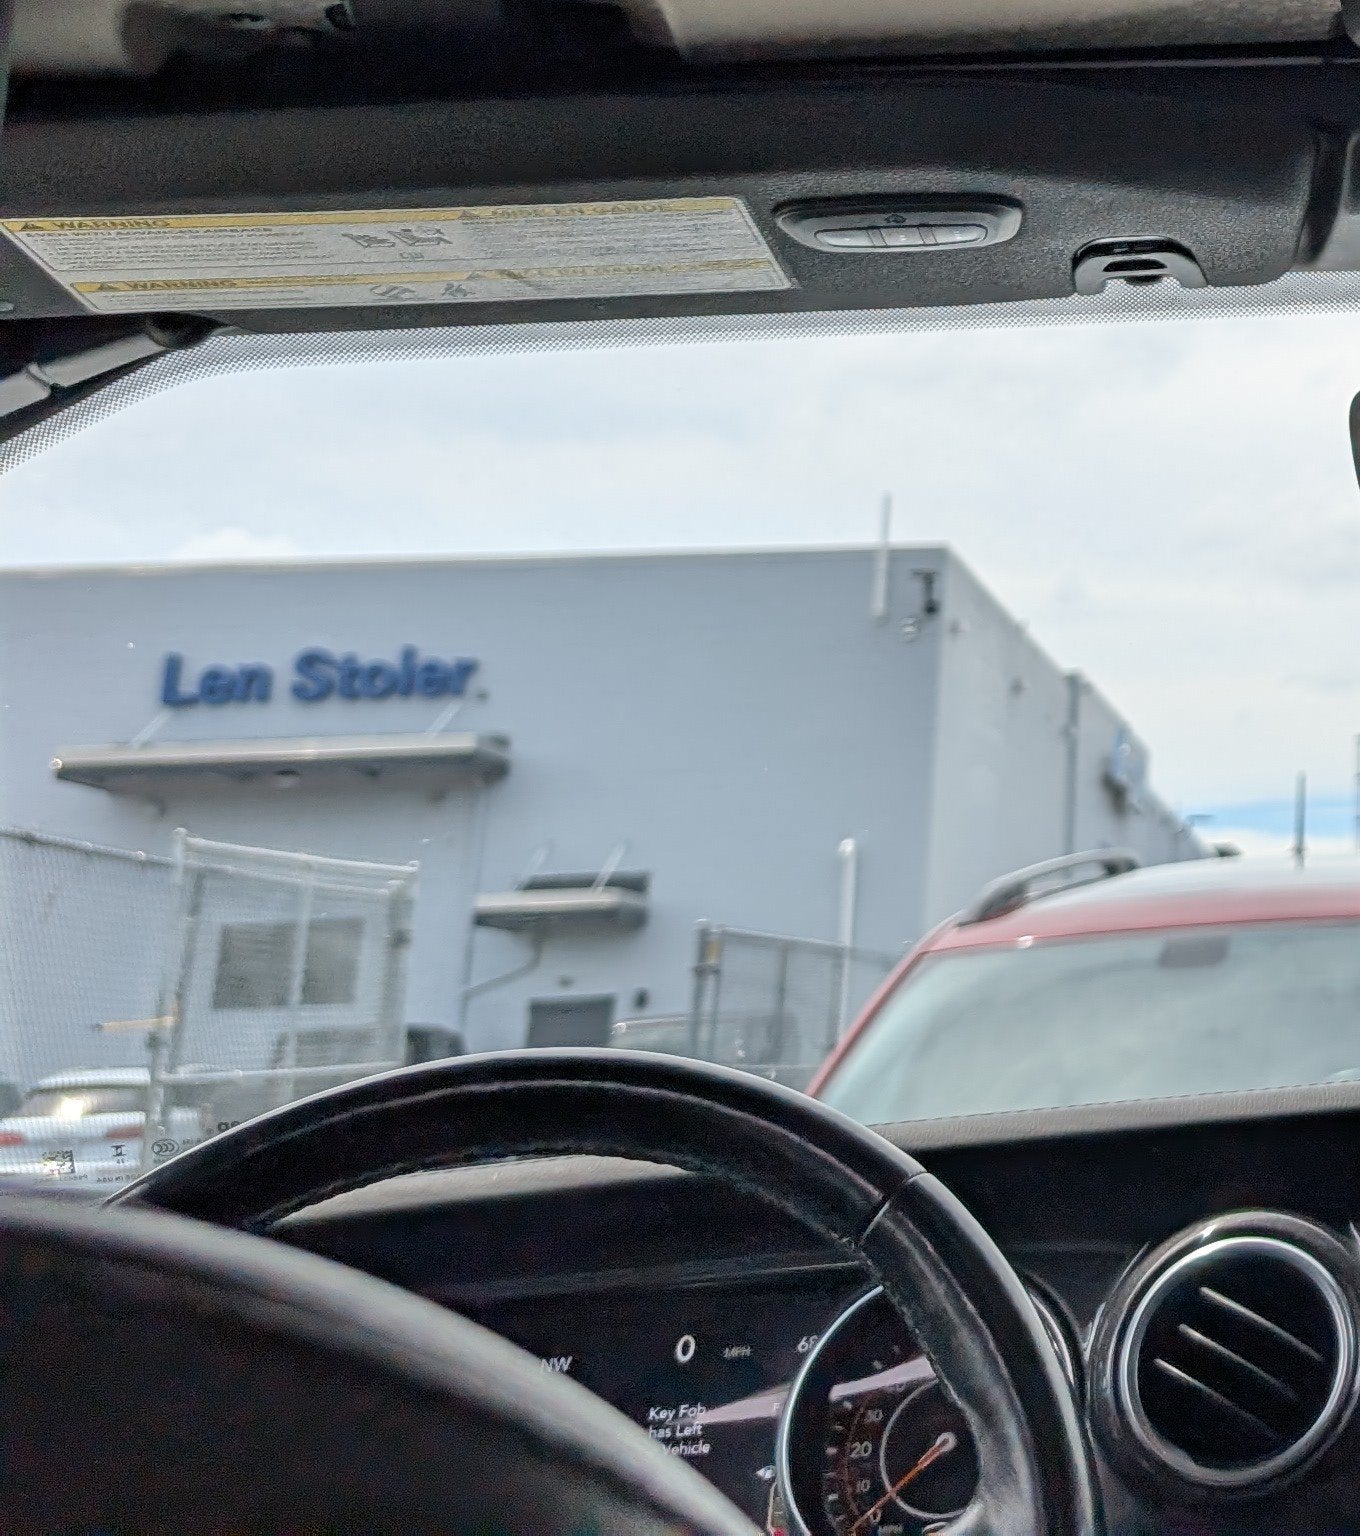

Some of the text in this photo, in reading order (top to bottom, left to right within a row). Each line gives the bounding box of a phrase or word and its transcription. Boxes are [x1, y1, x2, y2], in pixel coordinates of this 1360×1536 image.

[52, 219, 170, 230] WARNING
[128, 280, 237, 291] WARNING
[162, 643, 480, 706] Len Stoler
[674, 1334, 696, 1363] 0
[649, 1402, 707, 1424] Key Fob
[676, 1422, 703, 1437] Left
[850, 1441, 873, 1458] 20
